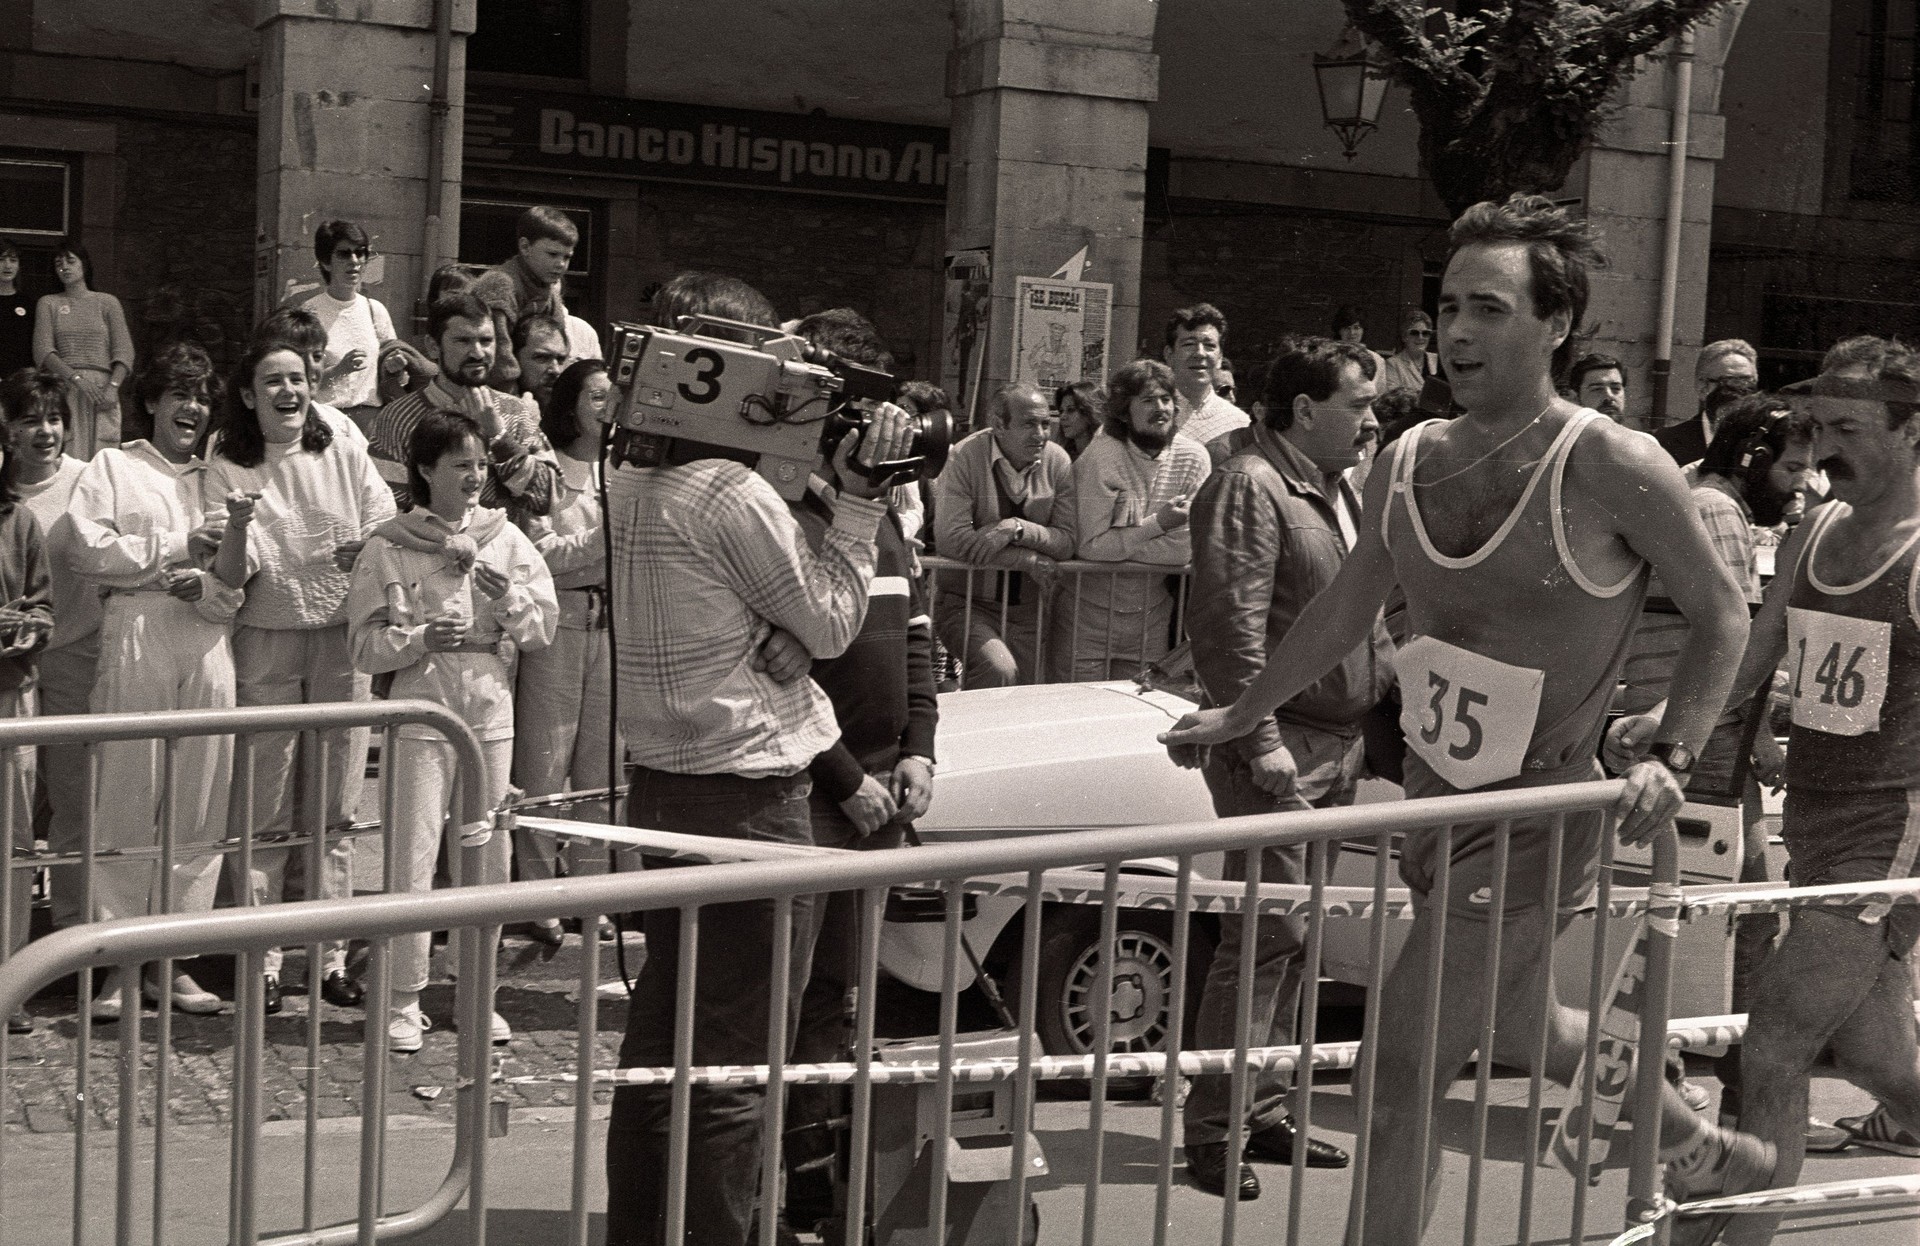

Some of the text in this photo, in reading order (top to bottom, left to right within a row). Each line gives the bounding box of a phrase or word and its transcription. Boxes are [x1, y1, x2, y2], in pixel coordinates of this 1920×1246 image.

[539, 108, 694, 165] Banco
[701, 123, 891, 182] Hispano
[677, 347, 725, 404] 3
[1793, 637, 1868, 709] 146
[1420, 670, 1489, 761] 35
